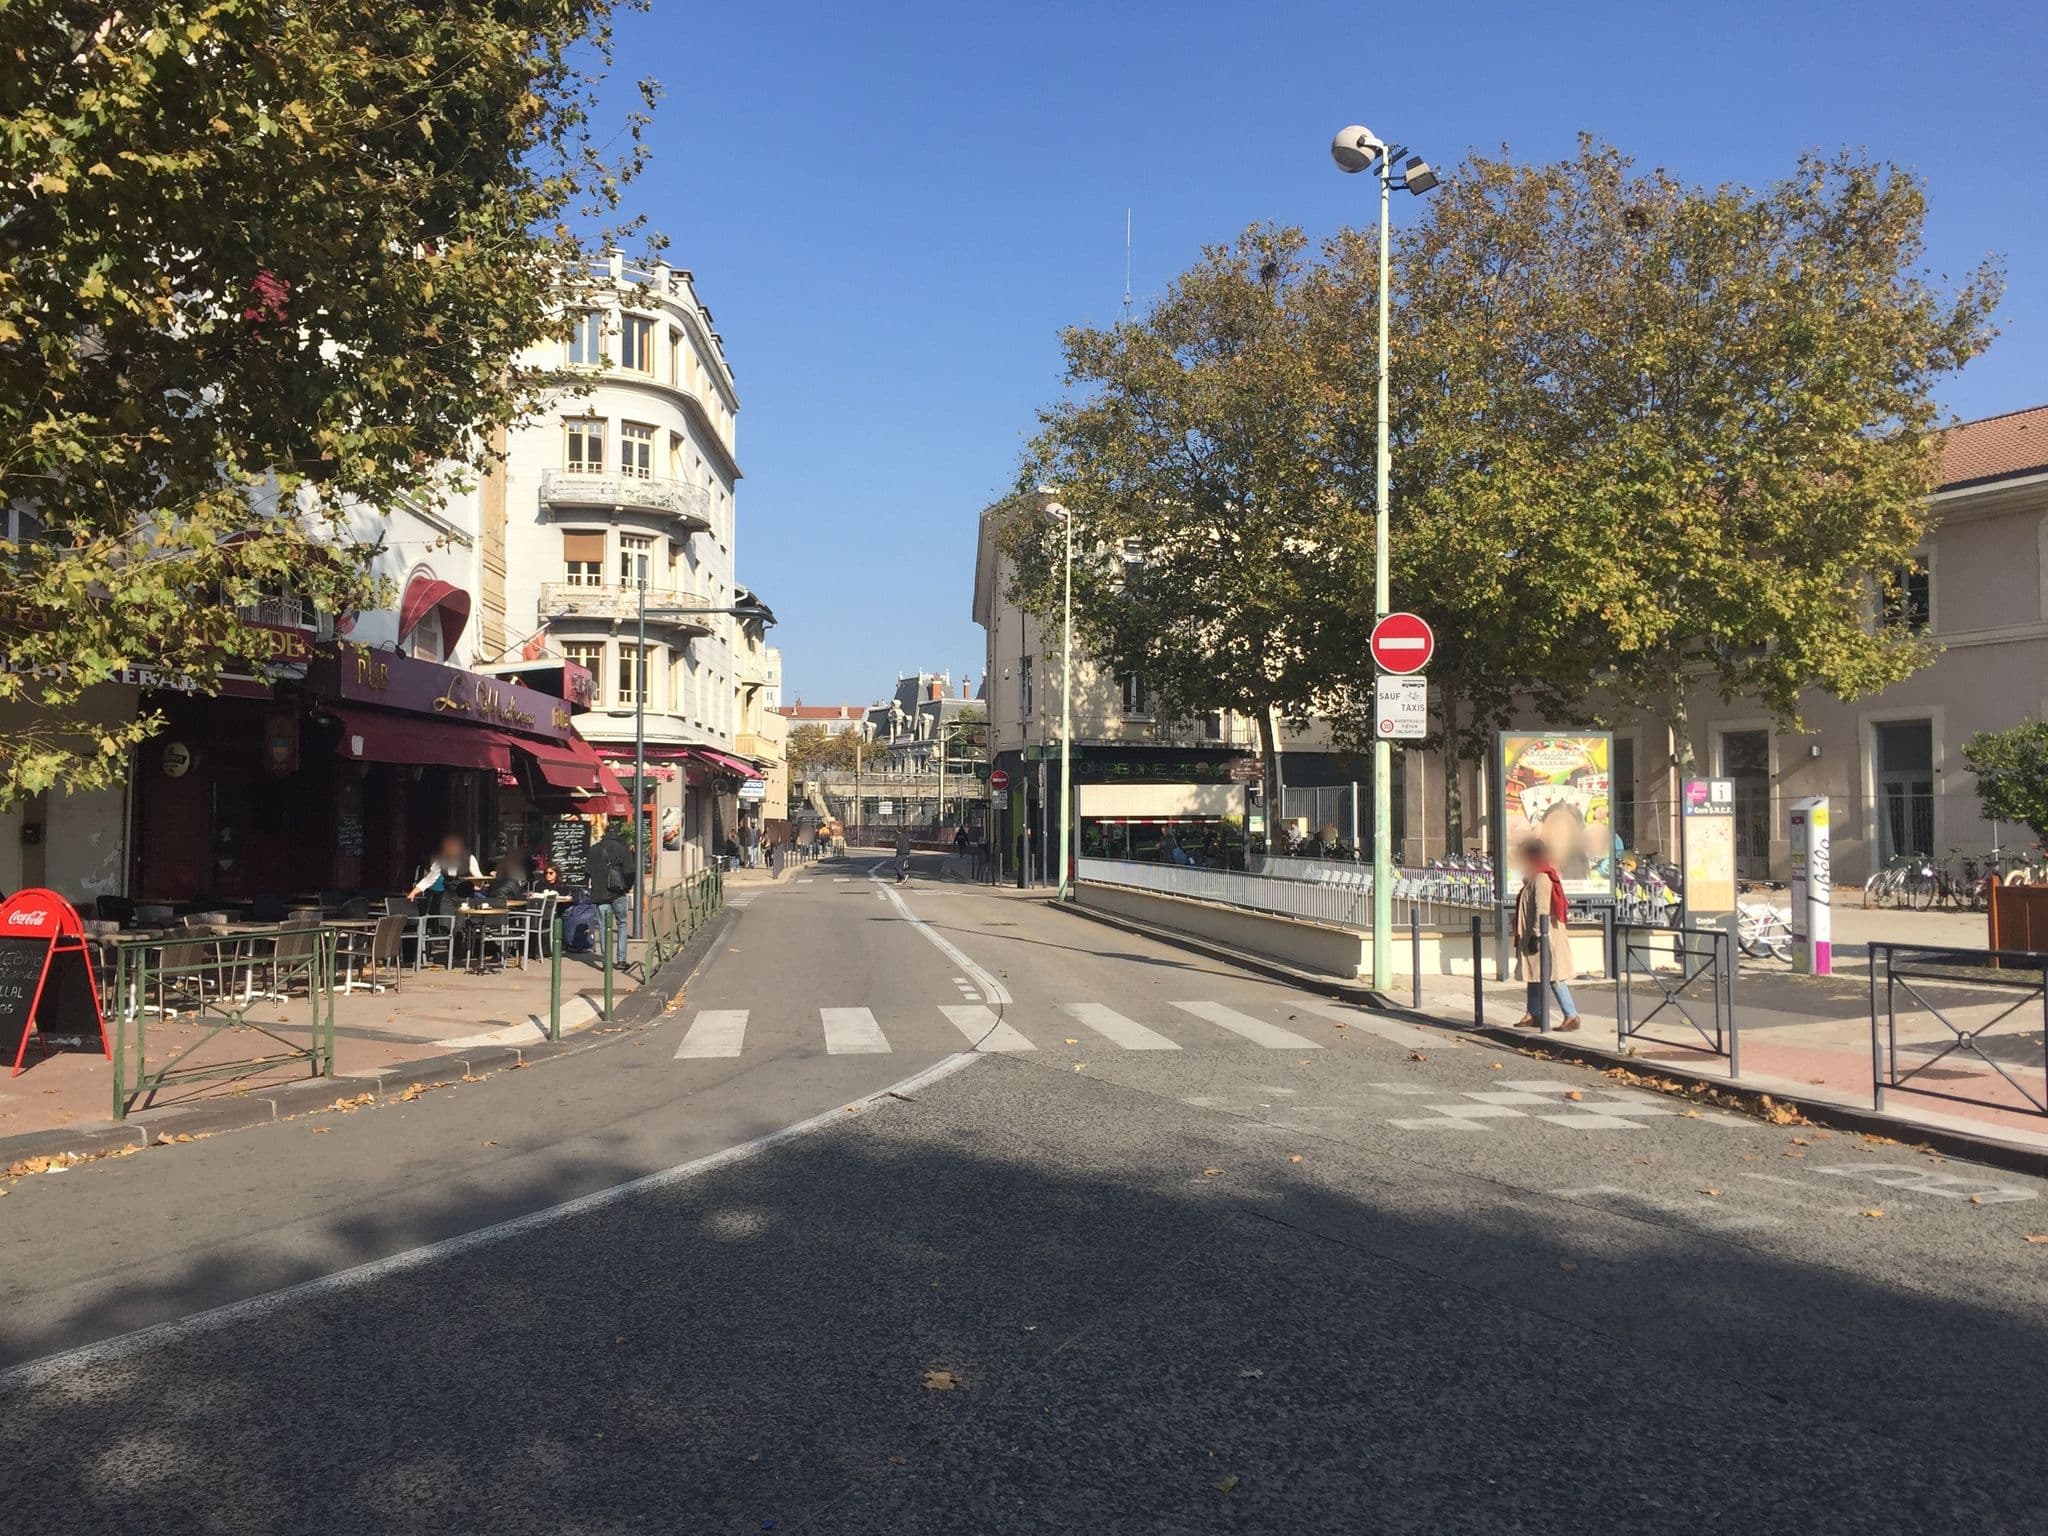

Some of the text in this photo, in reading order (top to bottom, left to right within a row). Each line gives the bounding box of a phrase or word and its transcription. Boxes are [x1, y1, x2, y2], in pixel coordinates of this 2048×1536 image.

[1378, 692, 1400, 700] SAUF
[1401, 703, 1425, 712] TAXIS
[8, 909, 48, 926] Coca-Cola
